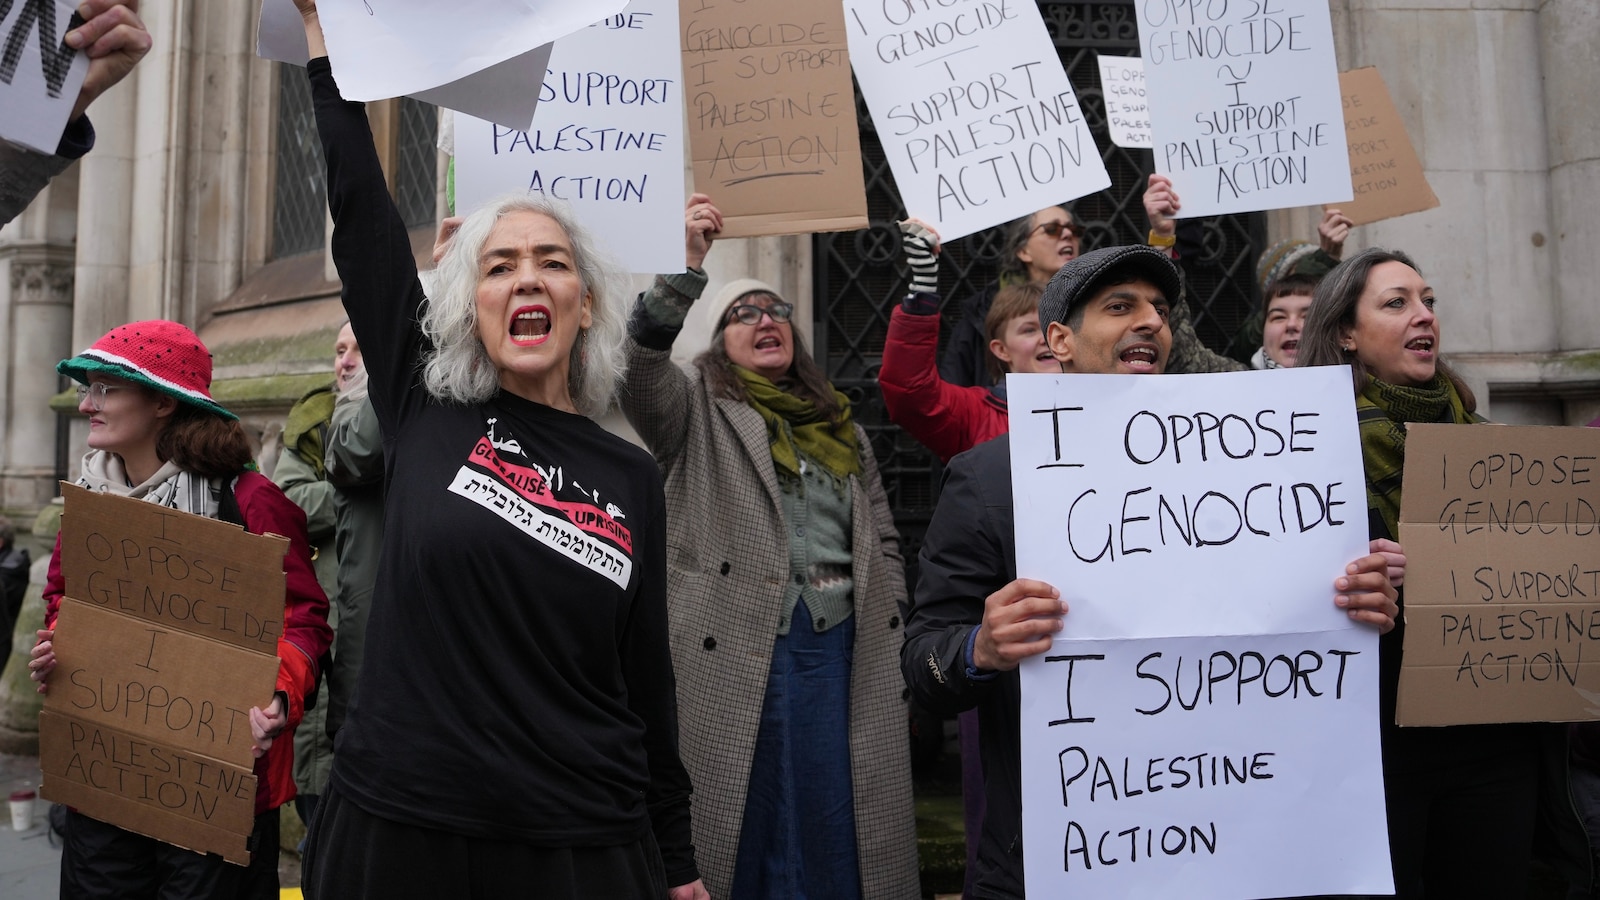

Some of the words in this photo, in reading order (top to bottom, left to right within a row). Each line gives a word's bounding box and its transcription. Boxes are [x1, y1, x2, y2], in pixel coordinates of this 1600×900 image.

[686, 20, 830, 56] GENOCIDE
[876, 3, 1019, 64] GENOCIDE
[1149, 15, 1311, 66] GENOCIDE
[538, 69, 674, 106] SUPPORT
[690, 60, 718, 87] I
[735, 48, 844, 79] SUPPORT
[943, 61, 956, 81] I
[1104, 66, 1119, 81] I
[694, 91, 838, 130] PALESTINE
[887, 61, 1042, 136] SUPPORT
[1107, 101, 1118, 114] I
[1196, 96, 1302, 136] SUPPORT
[1225, 81, 1248, 107] I
[493, 124, 667, 155] PALESTINE
[905, 91, 1080, 174] PALESTINE
[1345, 116, 1379, 131] CIDE
[710, 126, 838, 179] ACTION
[1165, 123, 1329, 173] PALESTINE
[1348, 139, 1390, 156] PORT
[527, 170, 647, 203] ACTION
[936, 125, 1082, 223] ACTION
[1217, 156, 1307, 204] ACTION
[1031, 406, 1085, 470] I
[1124, 409, 1320, 465] OPPOSE
[1442, 454, 1448, 490] I
[1469, 453, 1597, 490] OPPOSE
[464, 478, 534, 527] גלובלית
[1067, 482, 1346, 563] GENOCIDE
[1438, 497, 1600, 544] GENOCID
[153, 511, 182, 545] I
[536, 520, 625, 577] התקוממות
[86, 532, 241, 593] OPPOSE
[1451, 569, 1457, 598] I
[1474, 563, 1600, 602] SUPPORT
[88, 570, 279, 645] GENOCIDE
[1440, 609, 1600, 646] PALESTINE
[135, 629, 168, 673] I
[1456, 642, 1582, 688] ACTION
[70, 669, 249, 745] SUPPORT
[1044, 654, 1105, 727] I
[1135, 650, 1361, 715] SUPPORT
[70, 721, 250, 801] PALESTINE
[1058, 746, 1276, 807] PALESTINE
[65, 752, 219, 821] ACTION
[1064, 821, 1217, 872] ACTION
